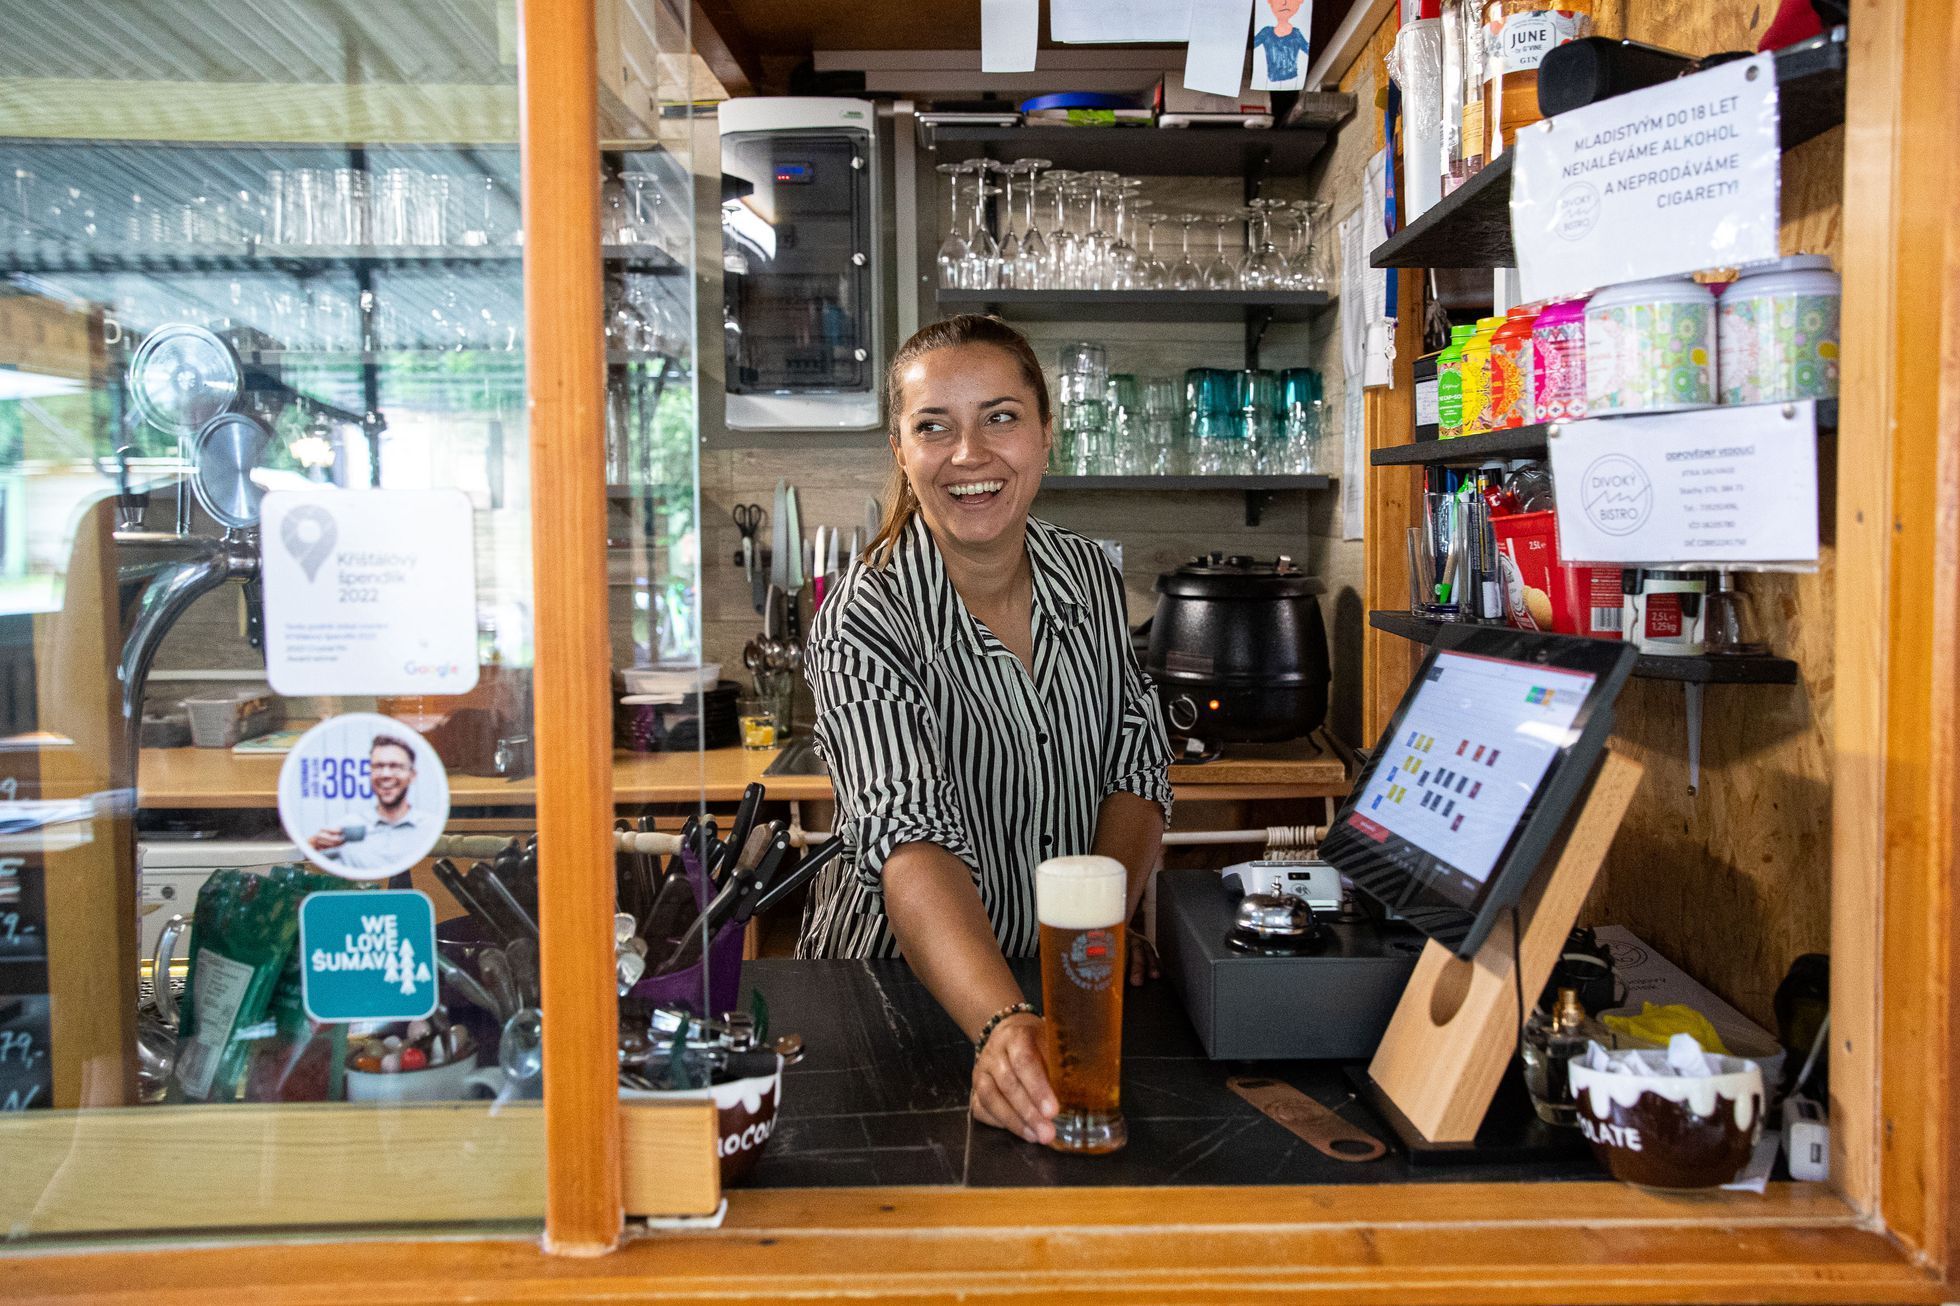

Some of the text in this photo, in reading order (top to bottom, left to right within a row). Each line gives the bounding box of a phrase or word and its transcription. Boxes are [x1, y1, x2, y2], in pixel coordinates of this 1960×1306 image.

[1511, 29, 1547, 49] JUNE
[1520, 55, 1539, 64] GIN
[1573, 96, 1739, 152] MLADISTVÝM DO 18 LET
[1562, 124, 1739, 179] NENALÉVÁME ALKOHOL
[1604, 153, 1740, 196] A NEPRODÁVÁME
[1599, 507, 1638, 521] BISTRO
[338, 588, 380, 603] 2022
[404, 659, 459, 678] Google
[322, 758, 373, 799] 365
[361, 914, 398, 934] WE
[345, 933, 398, 954] LOVE
[1576, 1112, 1643, 1152] OLATE
